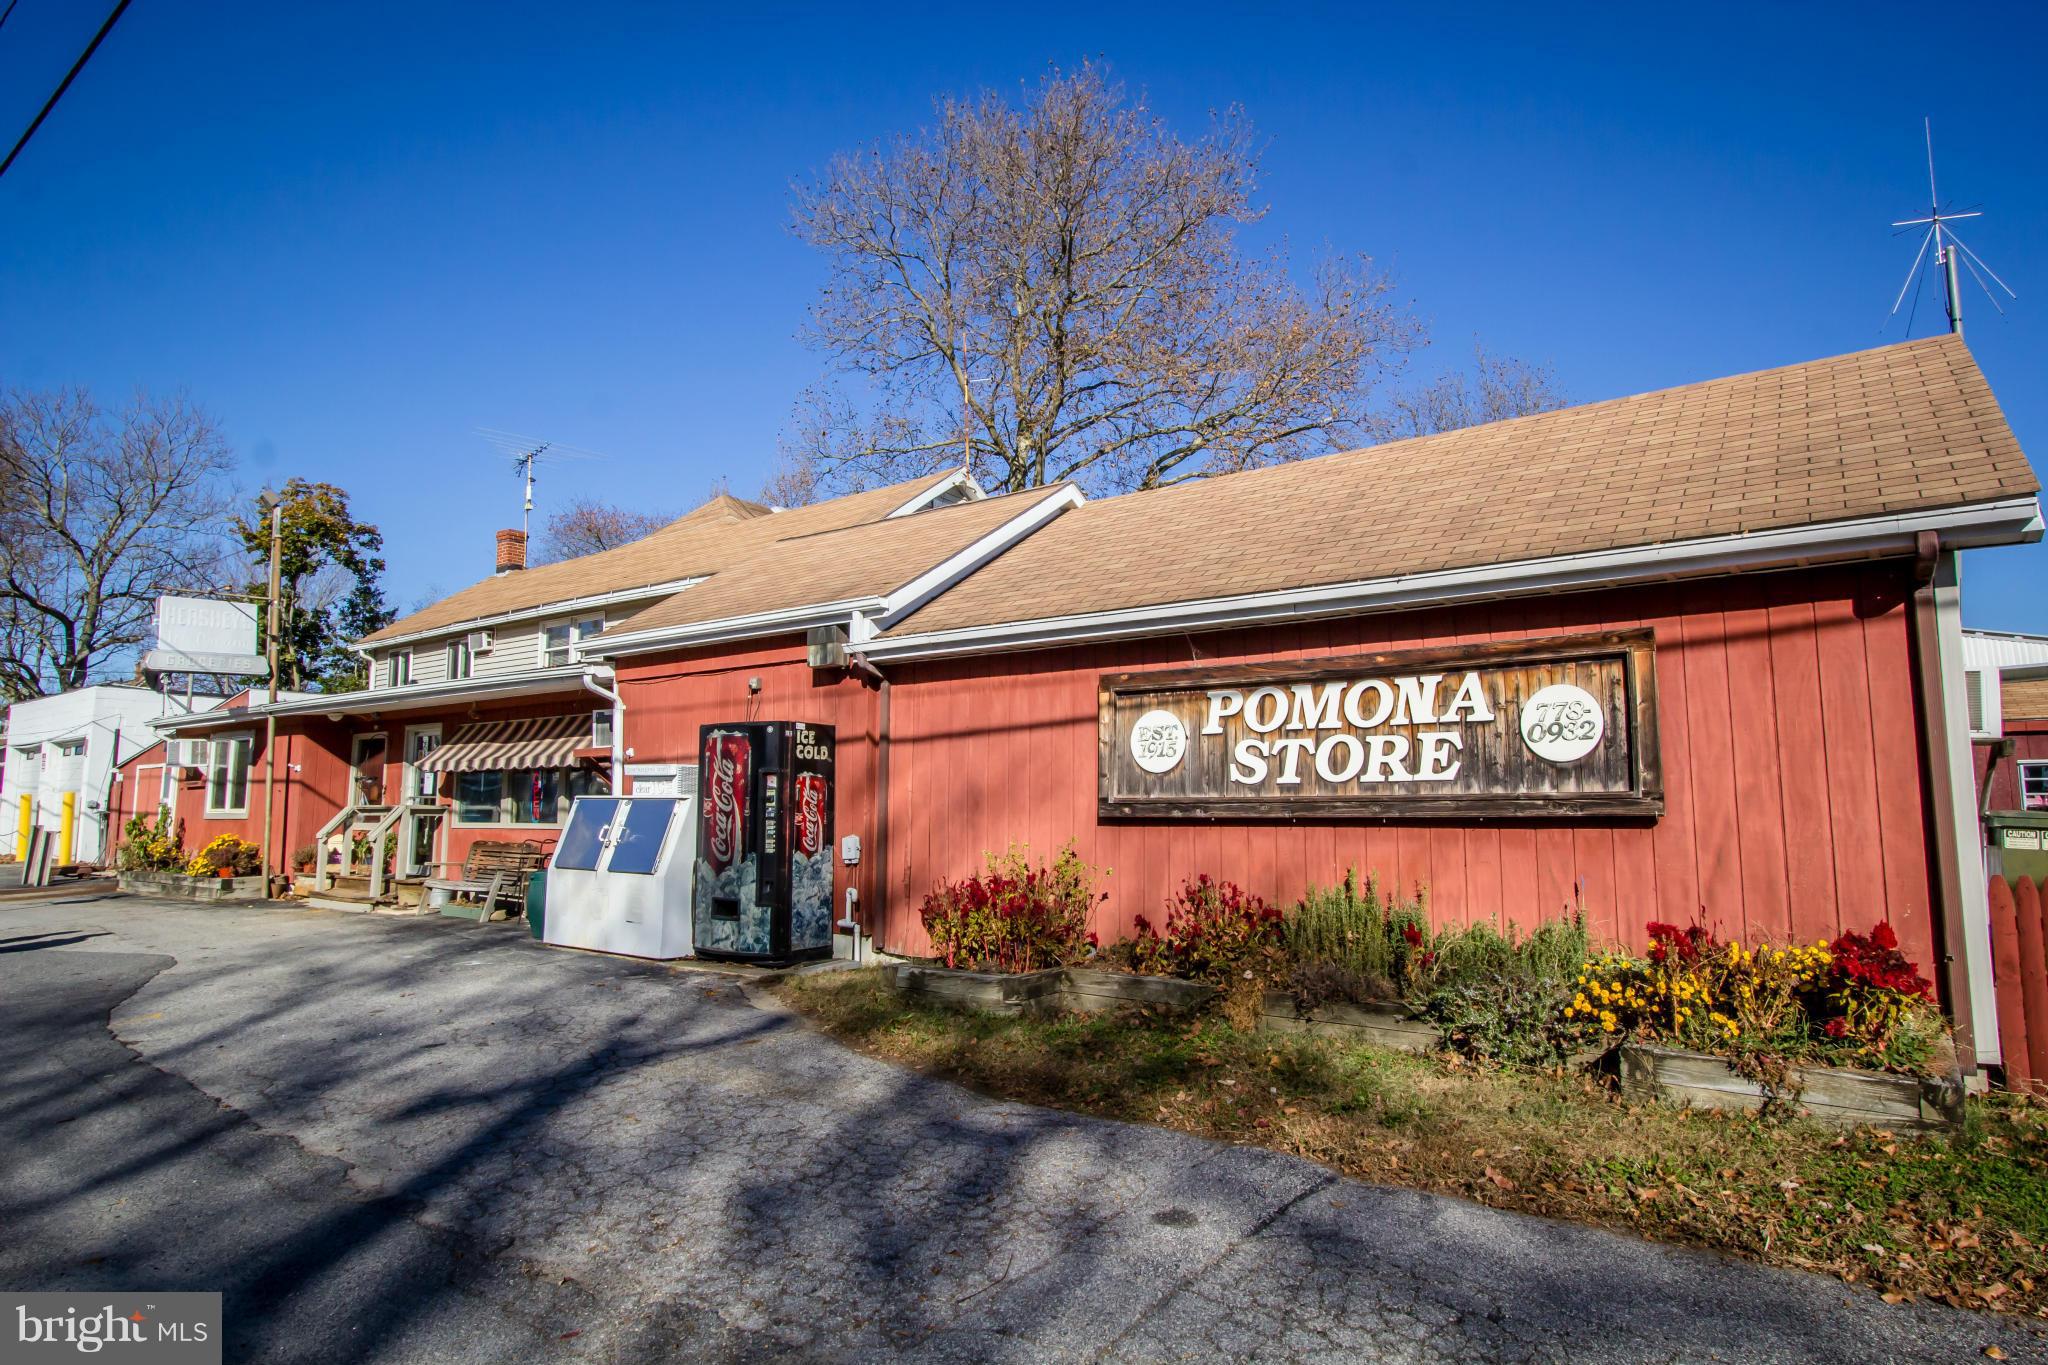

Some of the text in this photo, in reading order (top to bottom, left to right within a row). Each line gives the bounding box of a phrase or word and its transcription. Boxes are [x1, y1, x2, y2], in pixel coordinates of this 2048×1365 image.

[1202, 672, 1495, 735] POMONA
[1536, 700, 1592, 722] 778-
[796, 730, 816, 745] ICE
[1138, 724, 1178, 742] EST.
[1527, 719, 1596, 744] 0932
[796, 745, 829, 760] COLD
[1138, 742, 1177, 759] 1915
[1230, 732, 1464, 785] STORE
[2008, 830, 2036, 838] CAUTION
